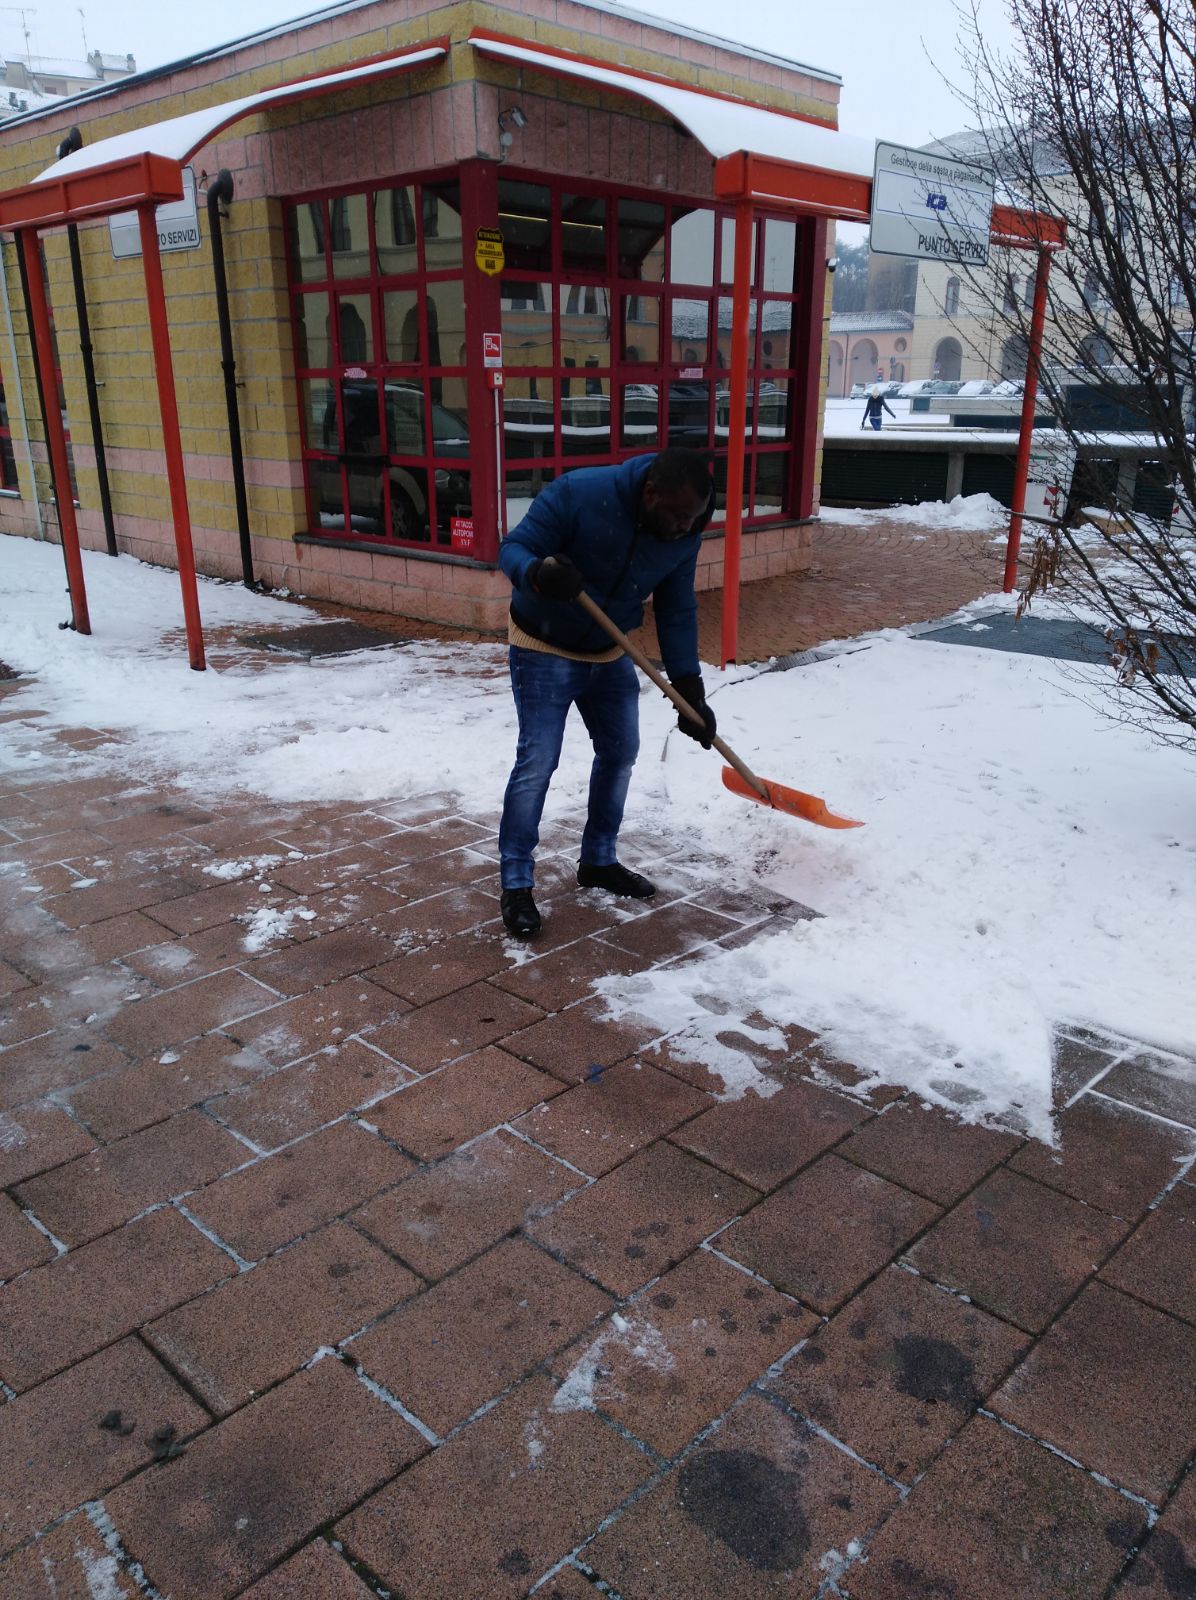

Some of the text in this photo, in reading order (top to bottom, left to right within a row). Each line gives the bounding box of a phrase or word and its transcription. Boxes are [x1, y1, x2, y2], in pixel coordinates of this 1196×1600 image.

[891, 153, 918, 169] Gestione
[918, 160, 932, 173] della
[933, 164, 949, 176] sosta
[168, 229, 197, 244] SERVIZI
[918, 234, 987, 259] PUNTO SERVIZI
